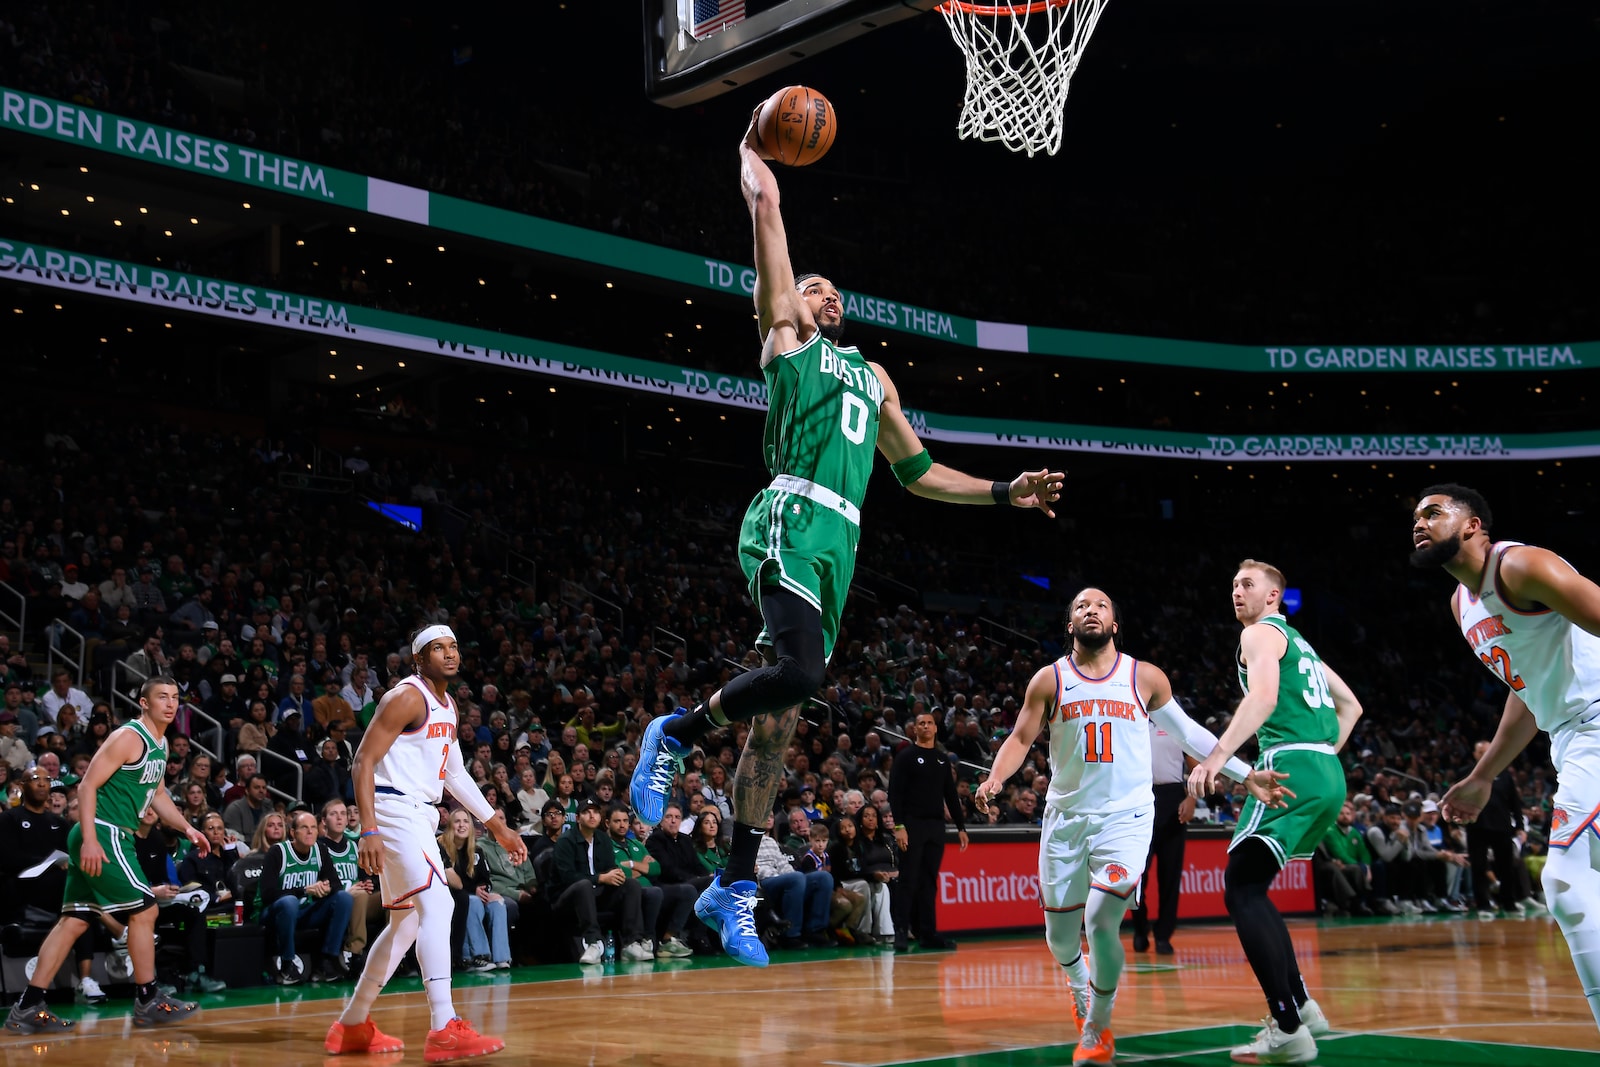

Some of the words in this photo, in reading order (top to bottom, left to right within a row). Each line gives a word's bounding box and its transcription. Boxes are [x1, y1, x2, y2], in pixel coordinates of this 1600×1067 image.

[806, 98, 826, 149] Wilson
[0, 91, 102, 144] RDEN
[116, 119, 229, 173] RAISES
[238, 148, 334, 198] THEM.
[151, 270, 257, 315] RAISES
[265, 290, 356, 334] THEM.
[705, 260, 734, 288] TD
[901, 304, 958, 340] THEM.
[820, 343, 885, 408] BOSTON
[1265, 347, 1297, 368] TD
[1304, 347, 1407, 368] GARDEN
[1415, 347, 1497, 368] RAISES
[1503, 346, 1582, 367] THEM.
[682, 369, 710, 396] TD
[841, 391, 869, 445] 0
[1207, 436, 1236, 457] TD
[1242, 436, 1343, 456] GARDEN
[1351, 436, 1428, 456] RAISES
[1435, 436, 1511, 456] THEM.
[1298, 656, 1336, 709] 30
[1060, 699, 1096, 723] NEW
[1095, 699, 1137, 722] YORK
[439, 743, 449, 781] 2
[1084, 722, 1114, 763] 11
[939, 868, 1040, 905] Emirates
[1268, 861, 1309, 890] ETTER
